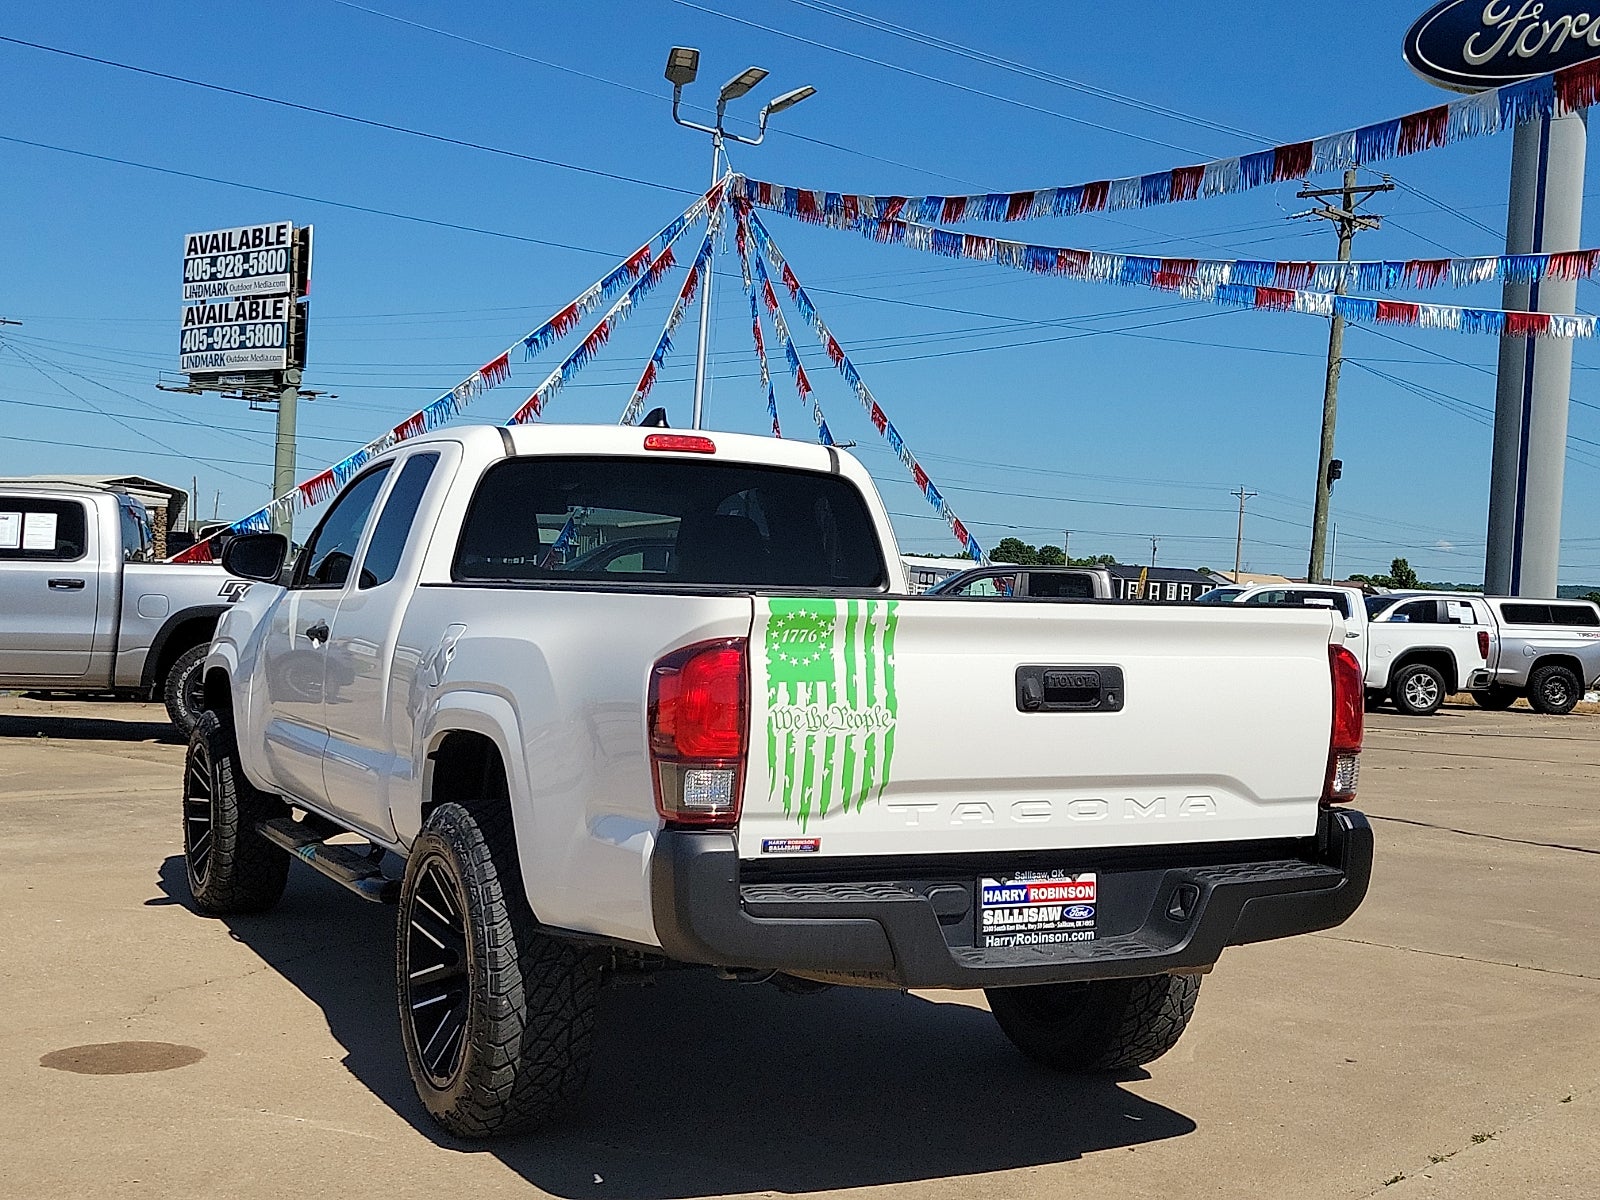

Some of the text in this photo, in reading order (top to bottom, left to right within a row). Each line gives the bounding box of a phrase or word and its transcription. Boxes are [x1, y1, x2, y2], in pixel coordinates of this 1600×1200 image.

[186, 225, 287, 257] AVAILABLE
[185, 249, 287, 281] 405-928-5800
[184, 281, 229, 299] LINDMARK
[229, 283, 252, 292] Outdoor
[184, 299, 284, 328] AVAILABLE
[182, 323, 283, 352] 405-928-5800
[182, 352, 226, 370] LINDMARK
[226, 354, 249, 363] Outdoor
[781, 628, 818, 643] 1776
[1051, 674, 1099, 687] TOYOTA
[770, 705, 892, 733] We the People
[887, 795, 1217, 826] TACOMA
[1014, 868, 1064, 880] Sallisaw, OK
[983, 885, 1094, 902] HARRY ROBINSON
[983, 906, 1089, 925] SALLISAW Ford
[985, 930, 1095, 948] HarryRobinson.com
